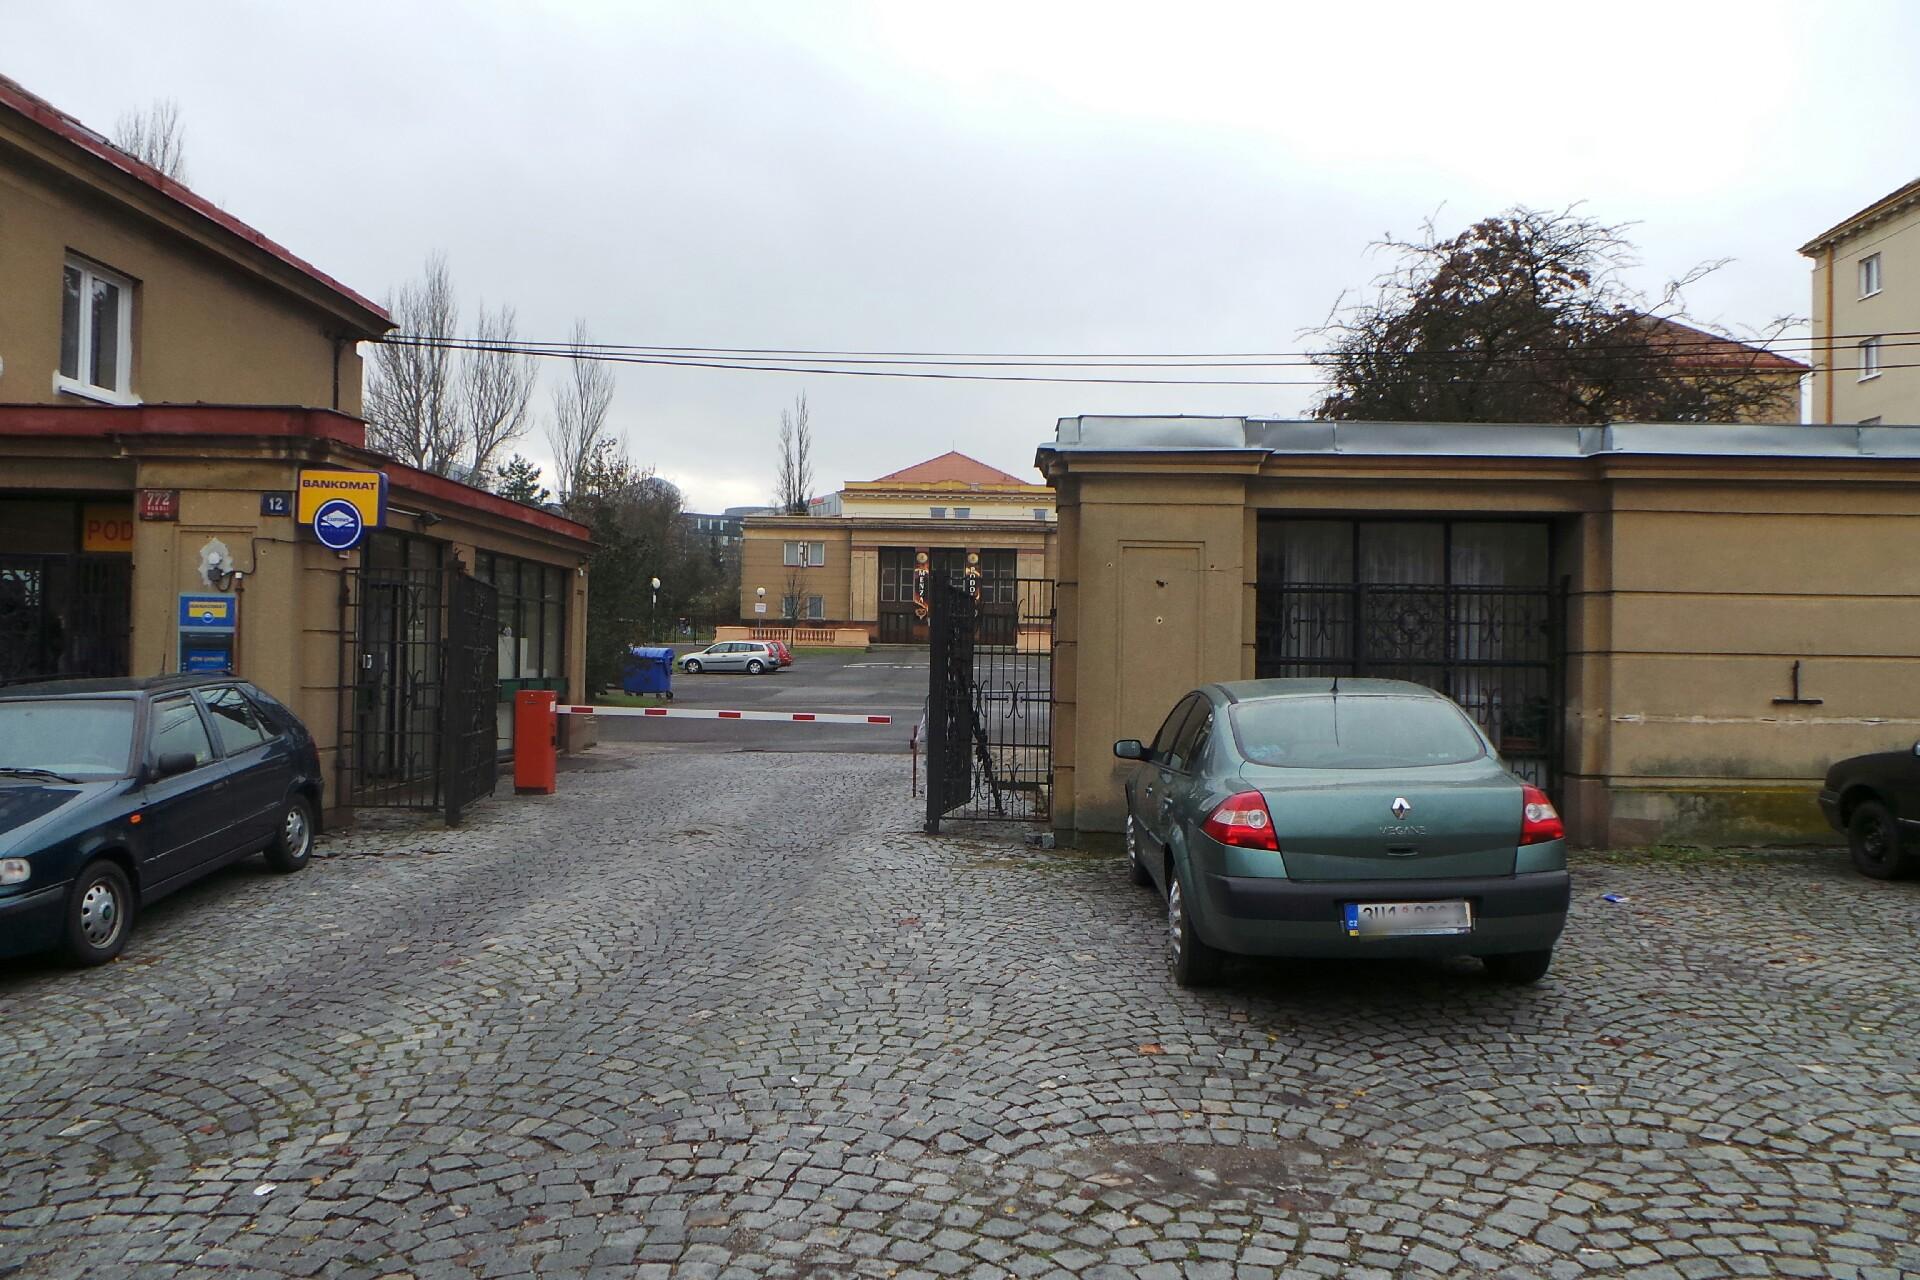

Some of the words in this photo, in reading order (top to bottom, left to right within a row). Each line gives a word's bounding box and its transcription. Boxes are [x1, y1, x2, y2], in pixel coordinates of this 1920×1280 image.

[302, 479, 376, 490] BANKOMAT
[147, 492, 170, 506] 772
[269, 497, 283, 511] 12
[918, 569, 926, 603] MENZA
[1379, 825, 1427, 835] MEGANE
